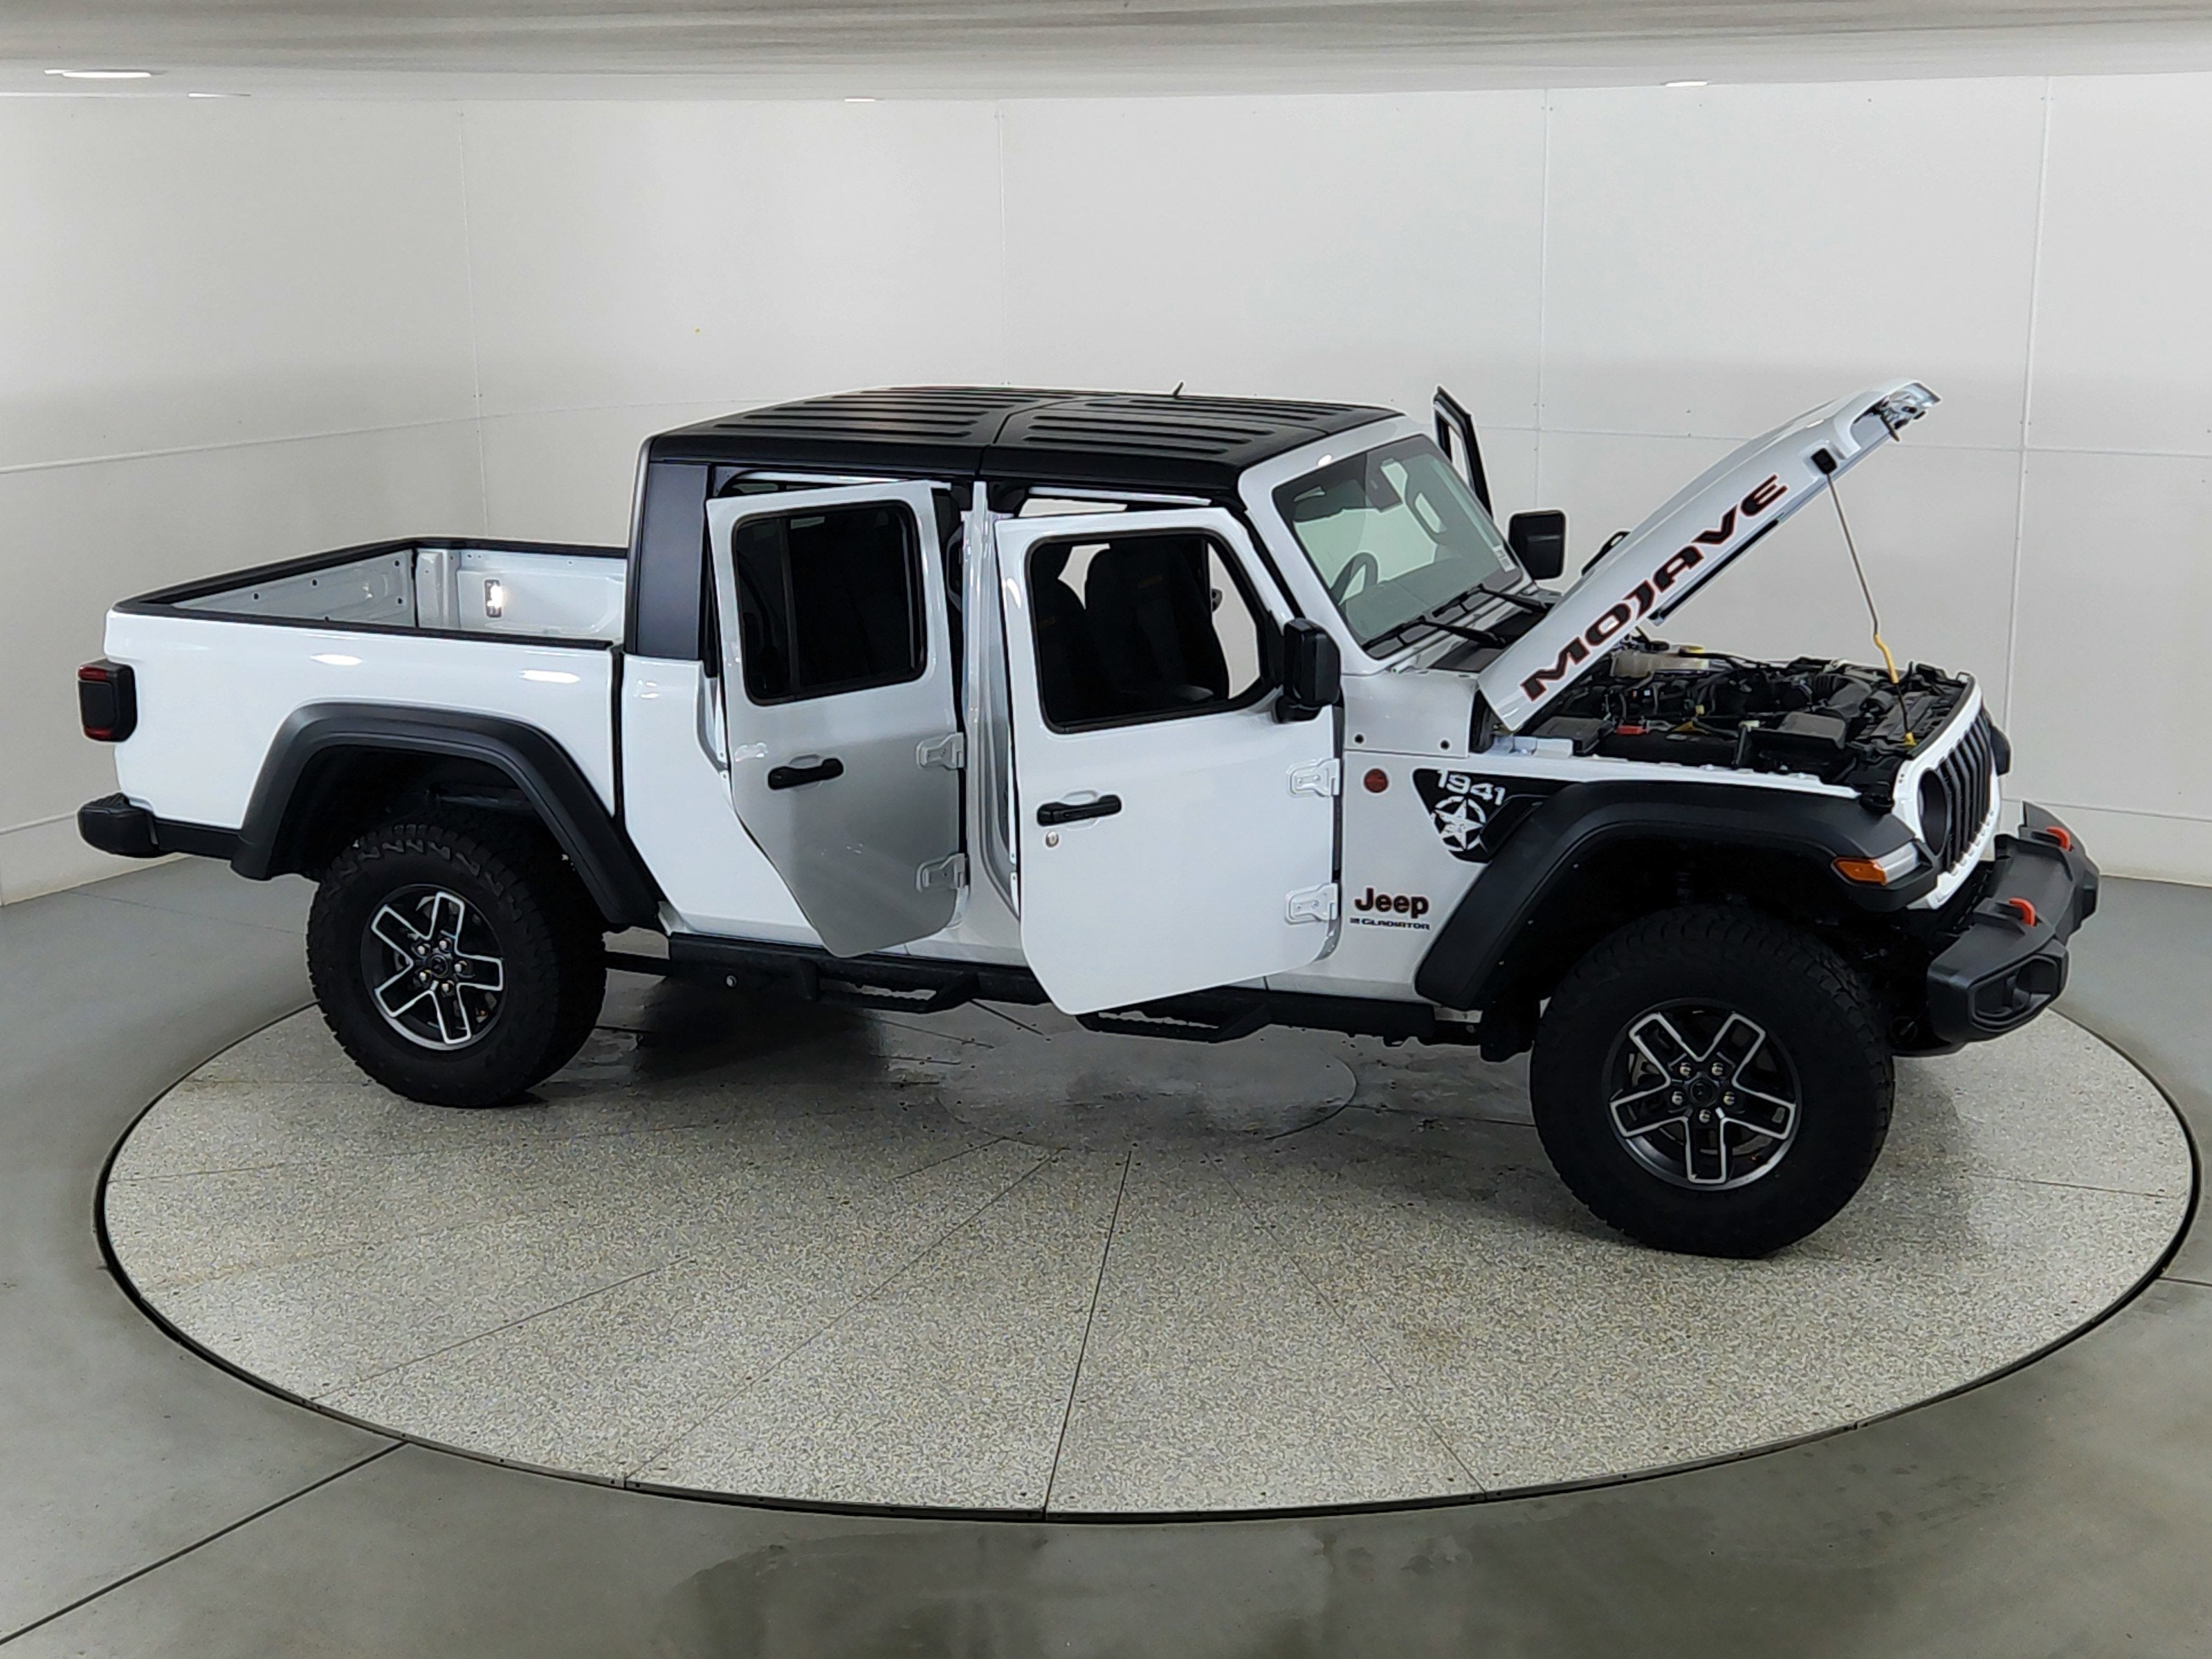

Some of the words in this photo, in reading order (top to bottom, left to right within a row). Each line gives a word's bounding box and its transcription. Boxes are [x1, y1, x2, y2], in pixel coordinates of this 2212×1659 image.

[1519, 474, 1789, 702] MOJAVE
[1437, 768, 1506, 806] 1941
[1354, 887, 1429, 919] Jeep
[1362, 918, 1431, 931] GLADIATOR
